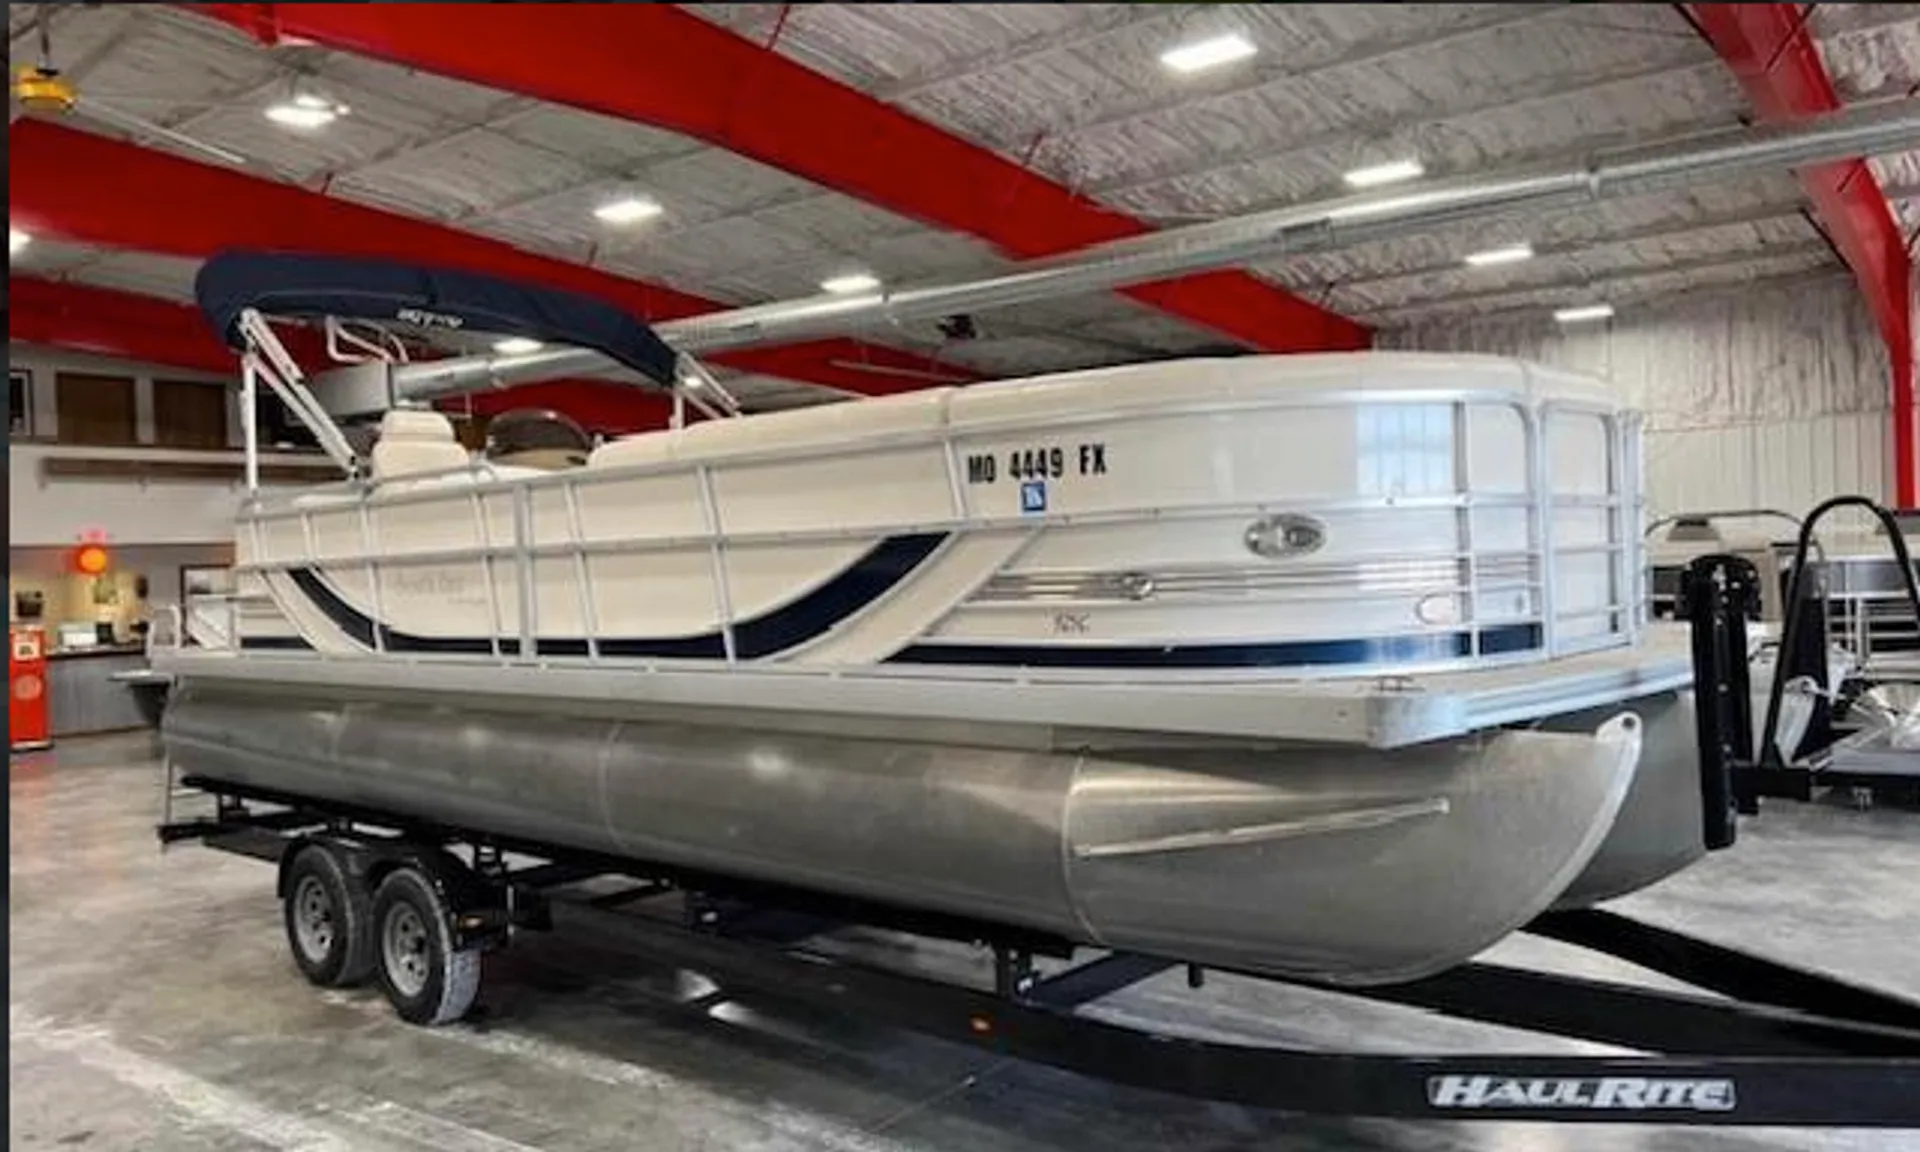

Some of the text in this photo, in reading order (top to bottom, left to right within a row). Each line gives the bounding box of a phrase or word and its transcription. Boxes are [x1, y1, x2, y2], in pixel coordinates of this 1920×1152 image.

[968, 444, 1106, 484] MO 4449 FX
